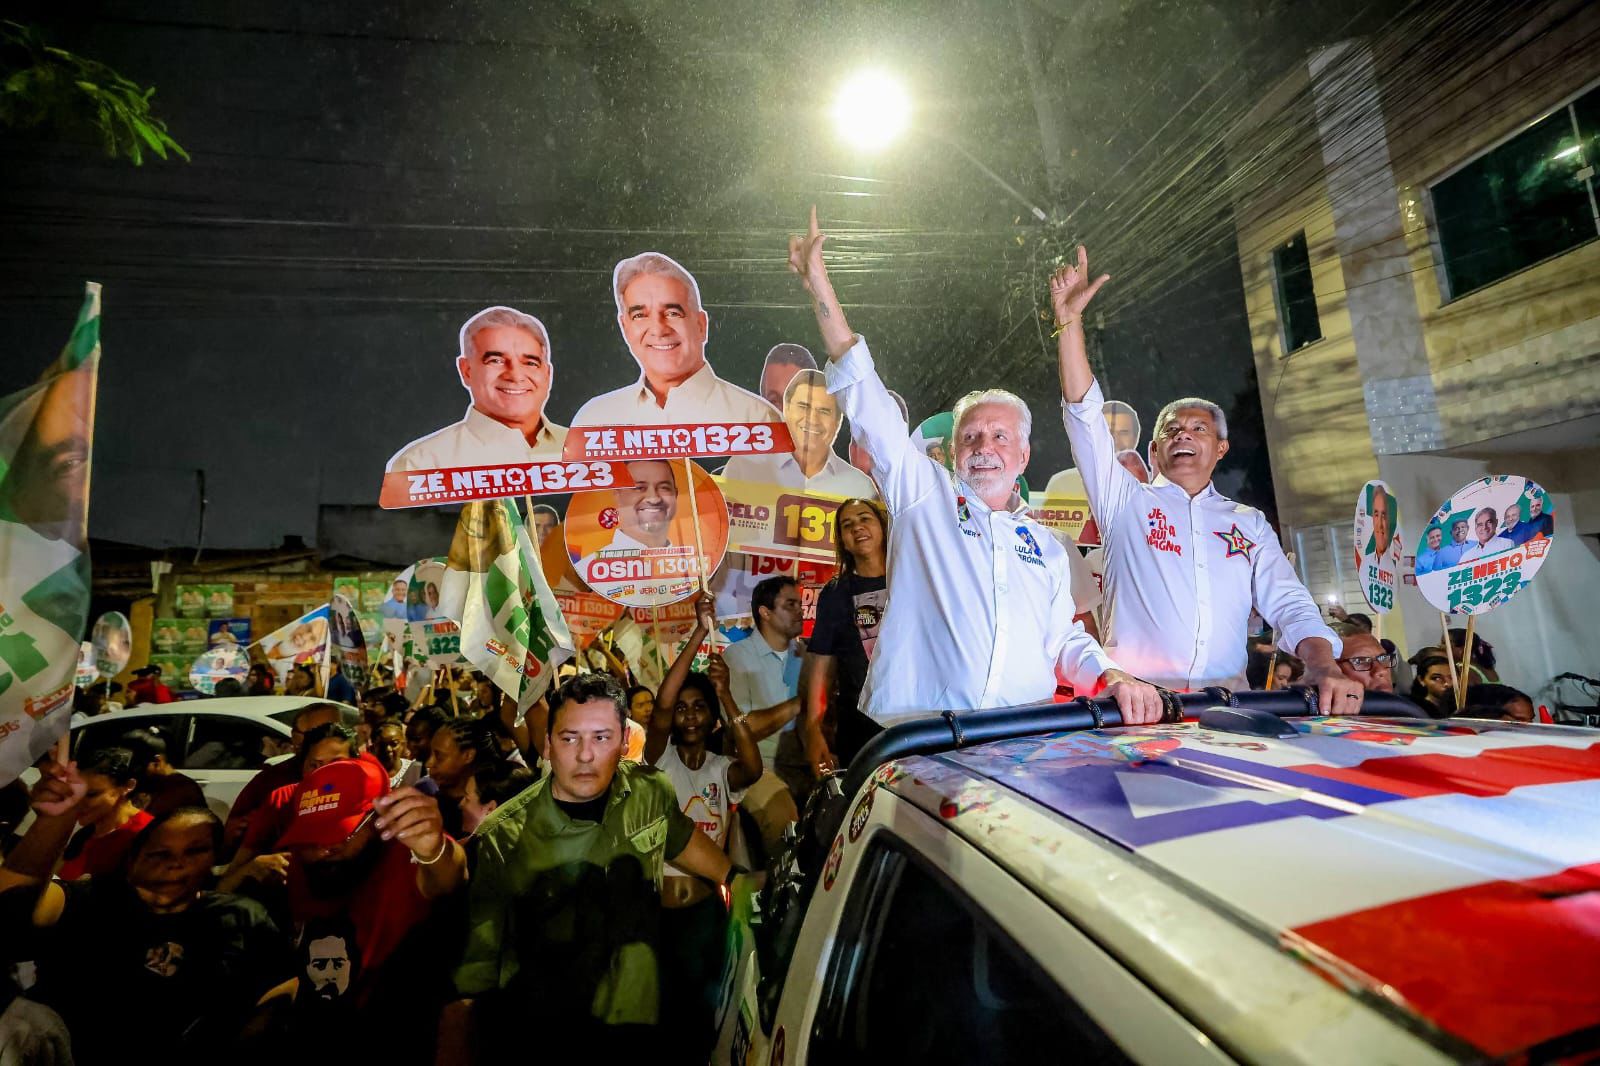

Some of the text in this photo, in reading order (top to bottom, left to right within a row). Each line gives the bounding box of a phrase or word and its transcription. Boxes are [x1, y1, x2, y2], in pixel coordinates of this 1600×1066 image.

[583, 425, 775, 453] ZÉ NETO 1323
[585, 447, 693, 457] DEPUTADO FEDERAL
[407, 461, 614, 494] ZÉ NETO 1323
[409, 485, 528, 501] DEPUTADO FEDERAL
[1014, 544, 1033, 556] LULA
[1231, 535, 1246, 550] 13
[591, 558, 652, 579] osni
[1368, 583, 1394, 610] 1323
[1447, 571, 1522, 609] 1323
